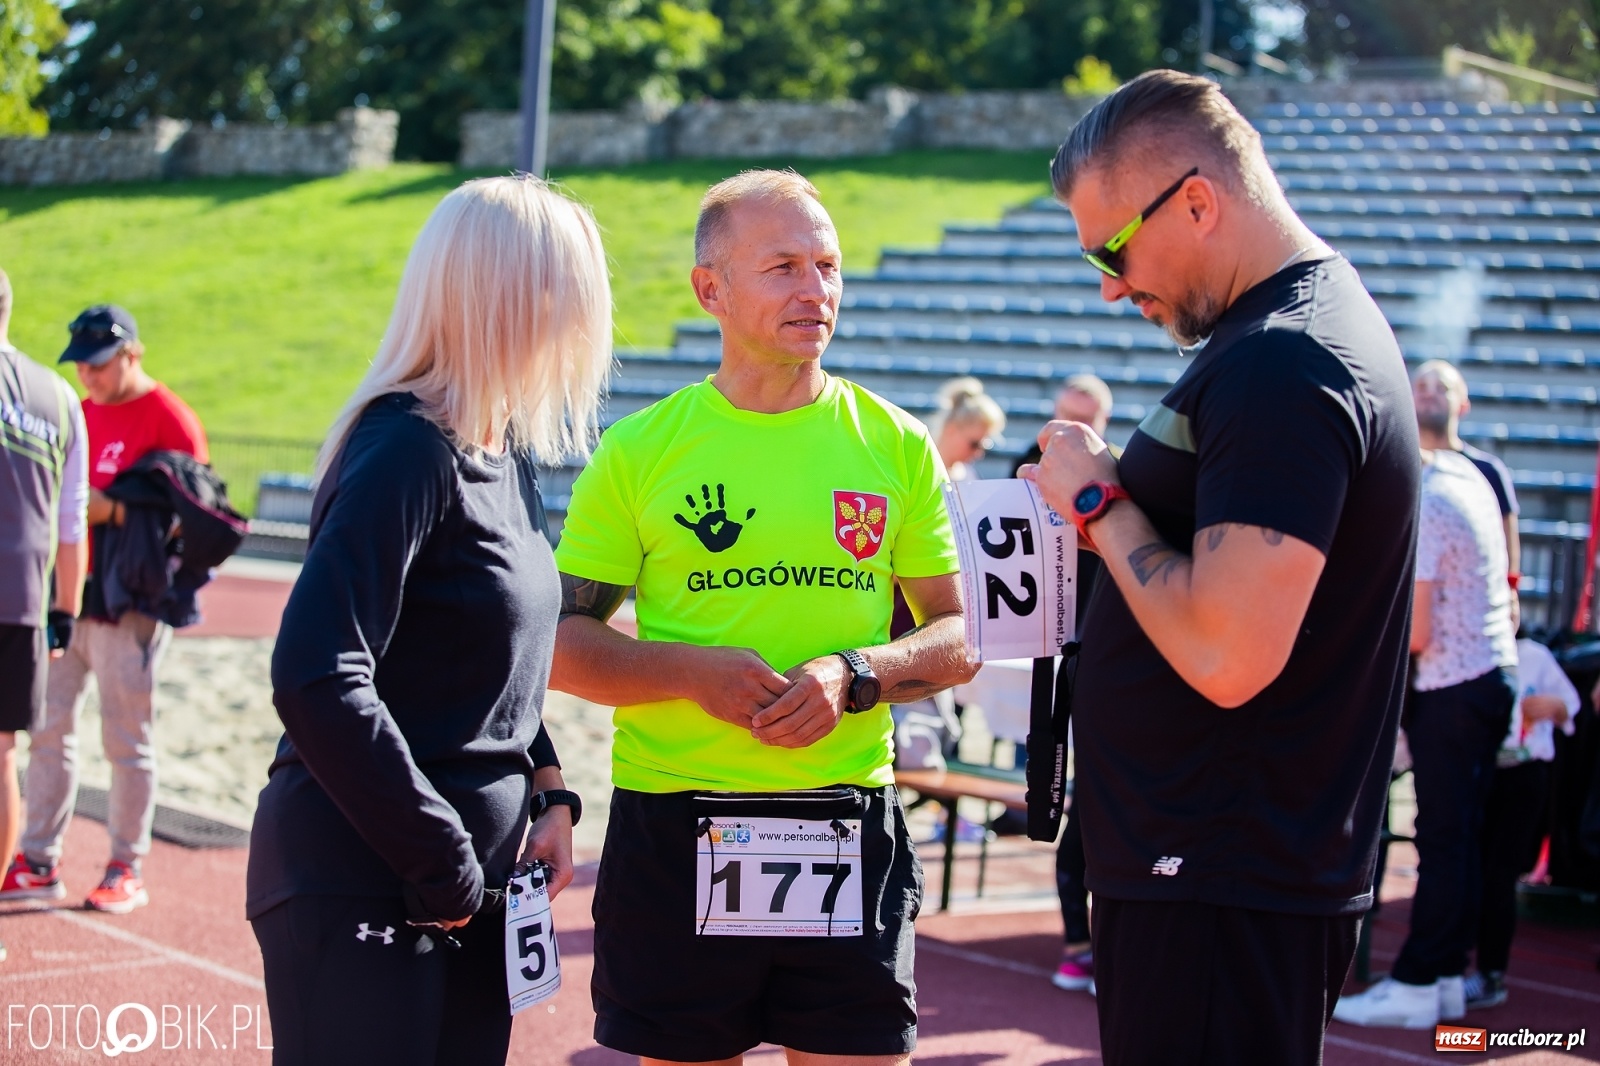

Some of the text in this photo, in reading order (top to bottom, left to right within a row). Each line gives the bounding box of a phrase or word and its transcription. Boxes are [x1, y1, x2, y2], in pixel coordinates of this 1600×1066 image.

[687, 560, 876, 592] GŁOGÓWECKA
[977, 515, 1038, 620] 52
[1055, 535, 1065, 649] www.personalbest.pl
[712, 860, 852, 914] 177
[517, 914, 558, 982] 51
